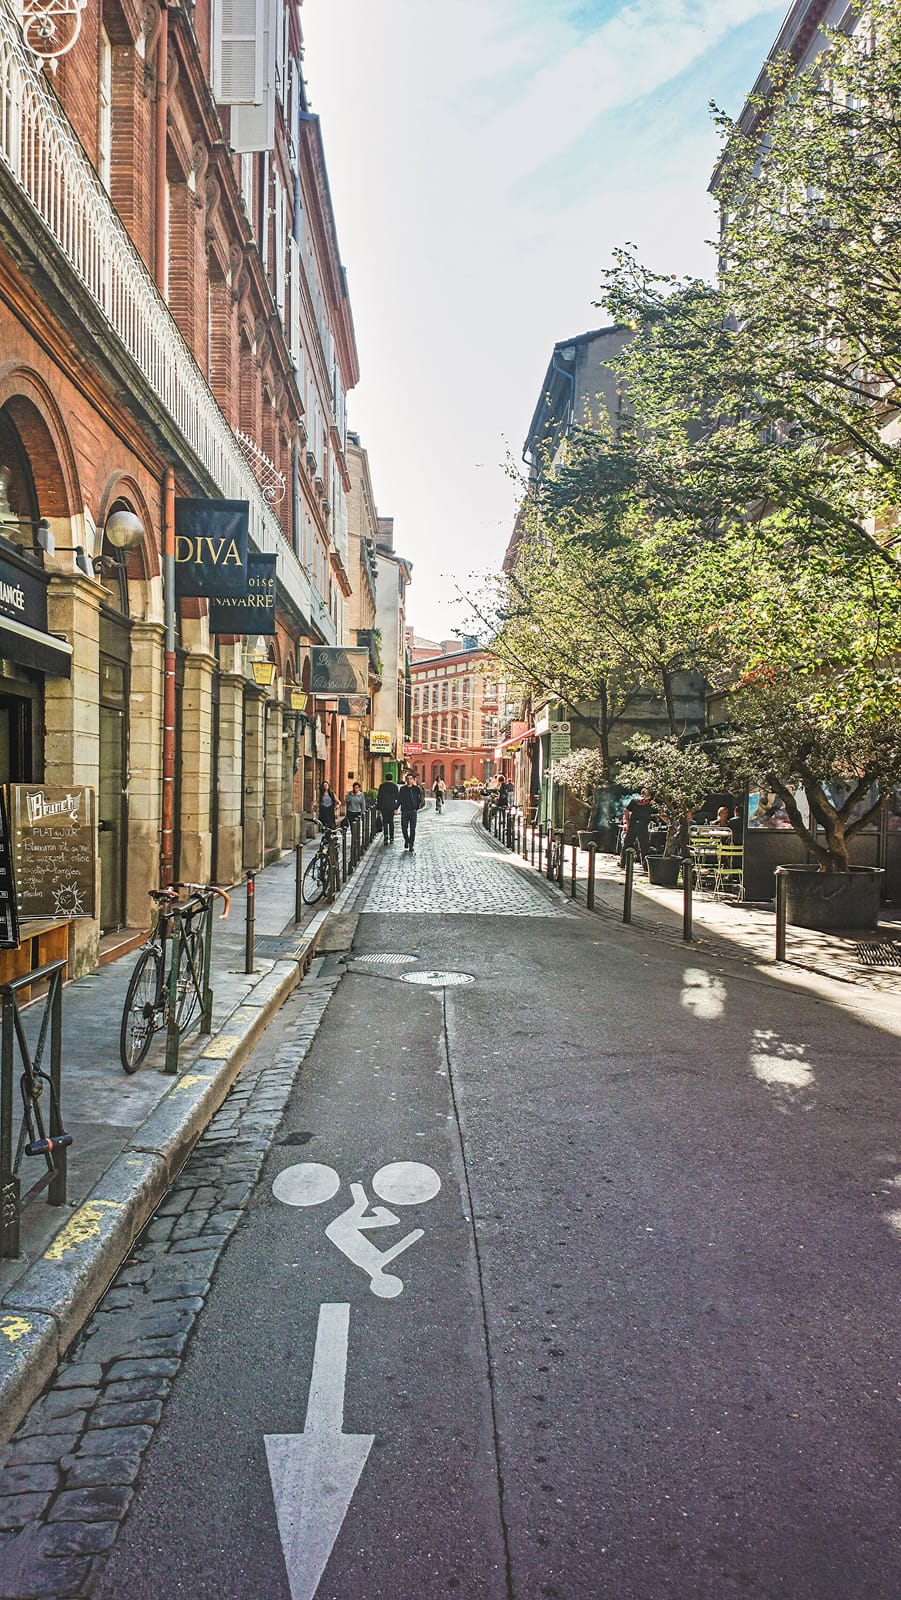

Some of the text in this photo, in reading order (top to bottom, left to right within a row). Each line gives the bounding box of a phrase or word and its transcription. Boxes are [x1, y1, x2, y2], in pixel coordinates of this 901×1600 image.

[175, 536, 243, 565] DIVA
[213, 594, 274, 608] NAVARRE
[29, 791, 79, 822] Brunch
[33, 827, 54, 837] PLAT
[61, 827, 79, 837] JOUR
